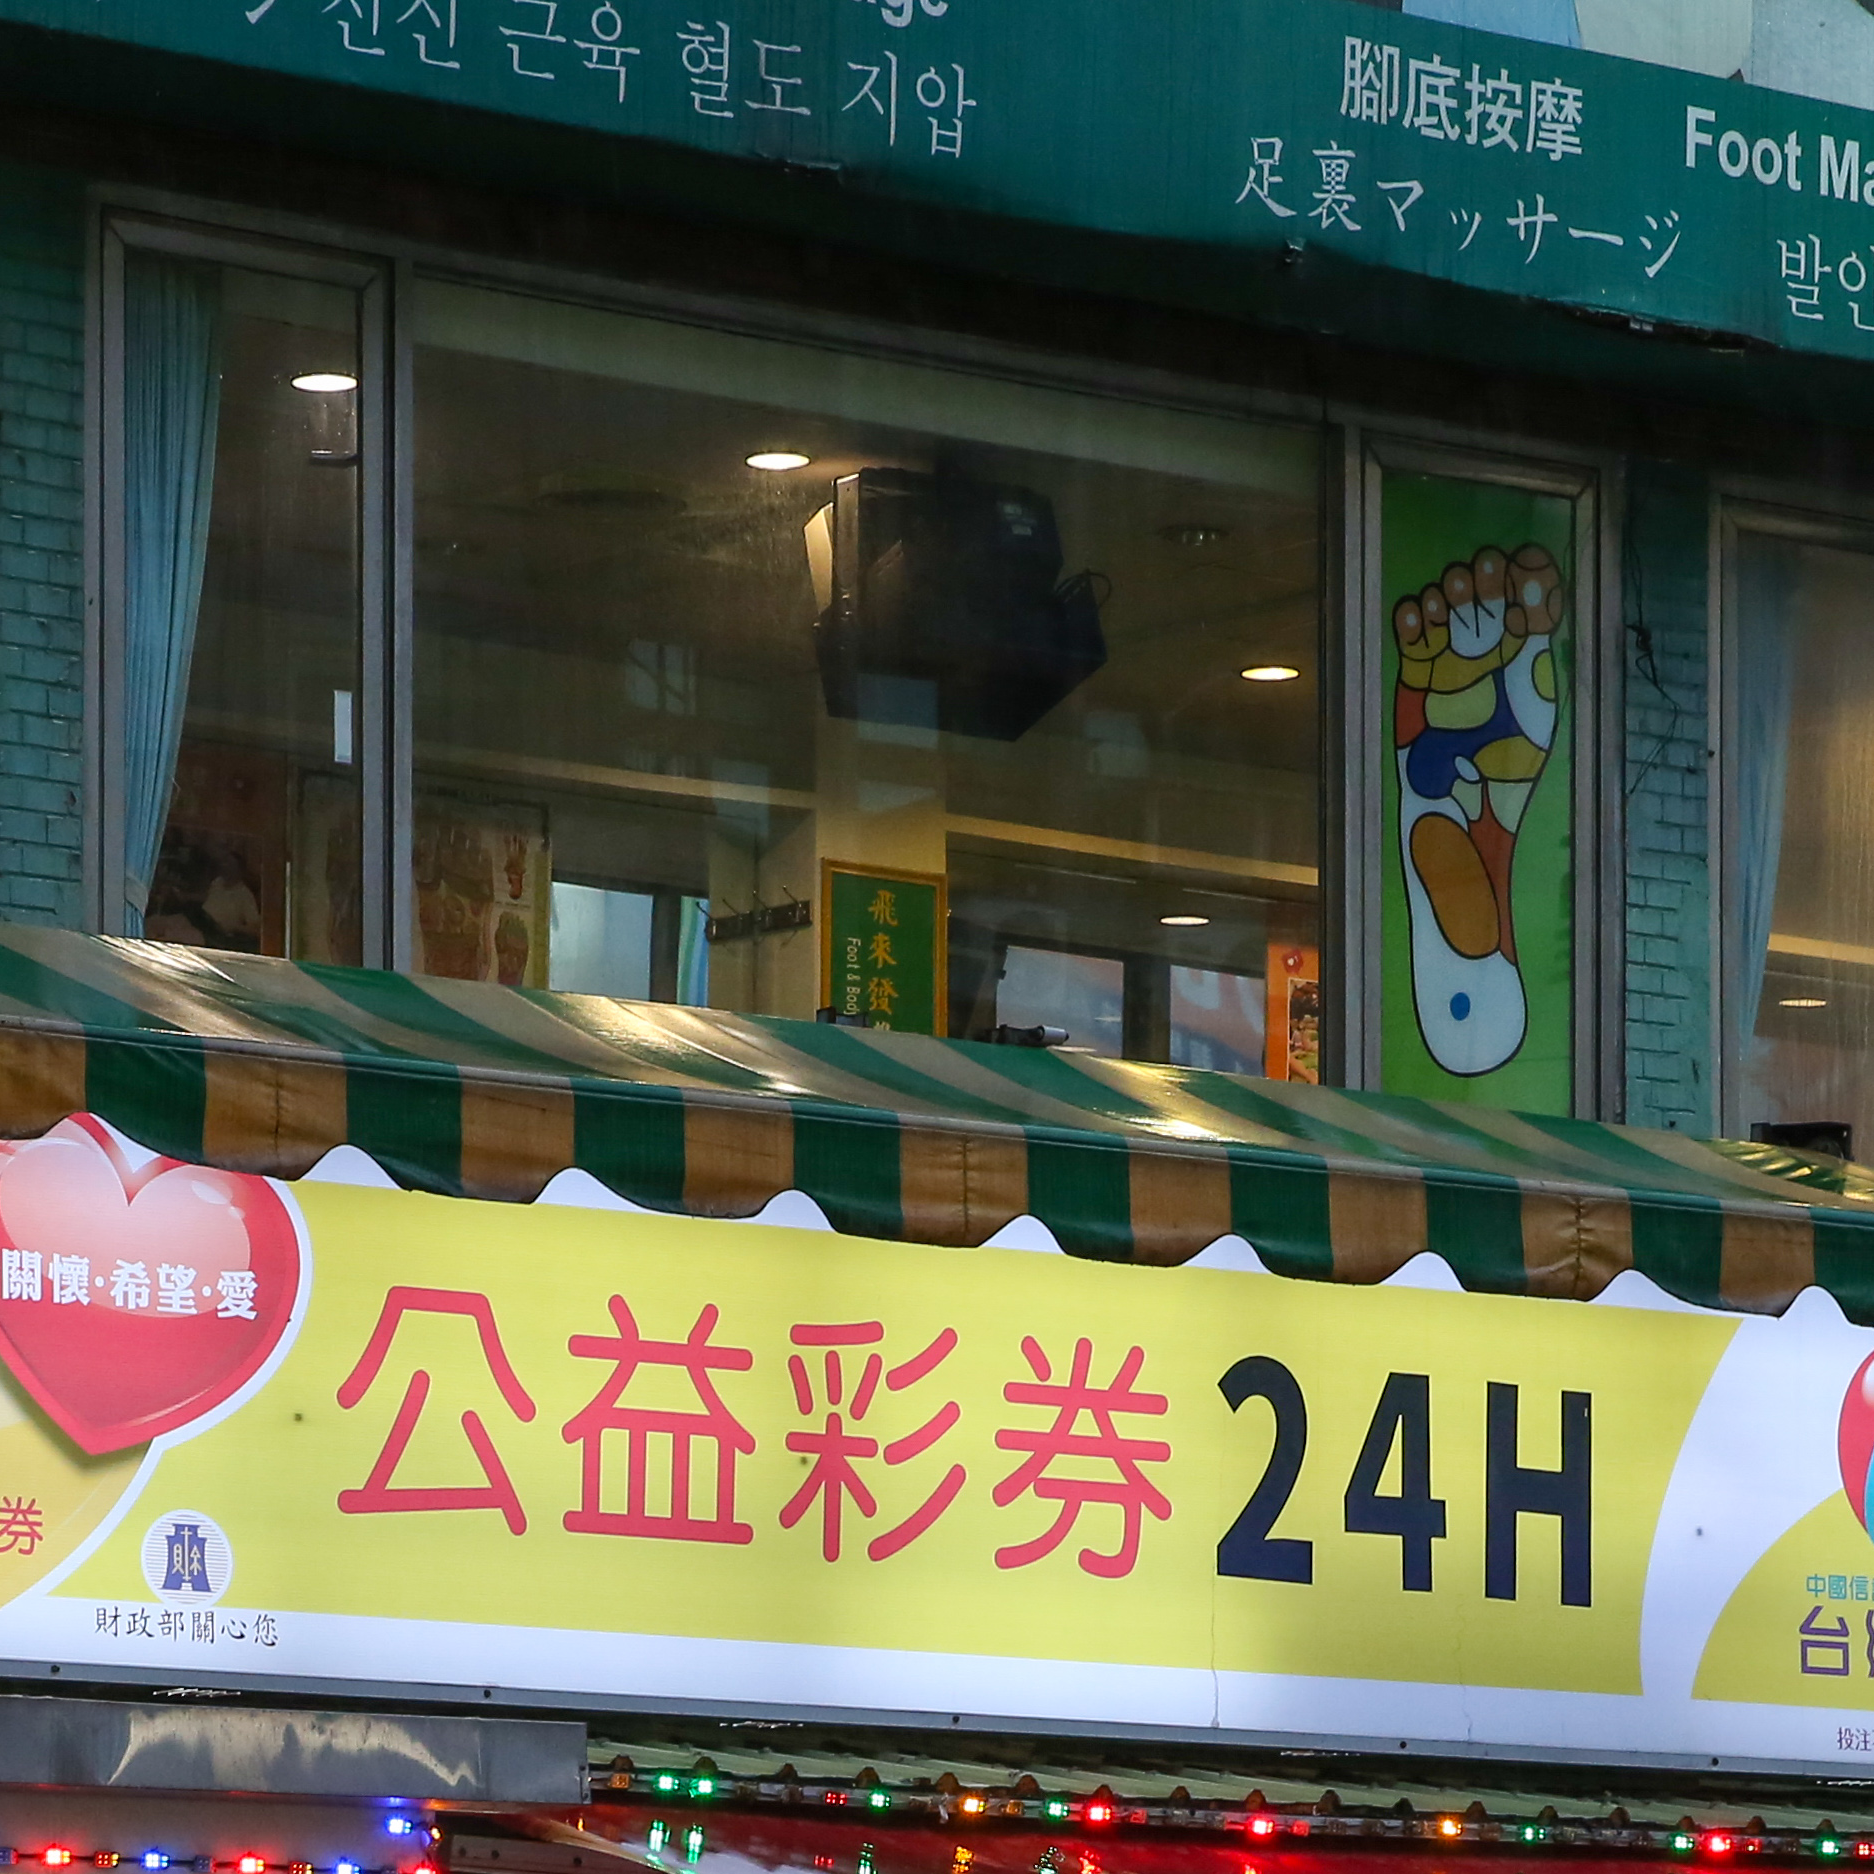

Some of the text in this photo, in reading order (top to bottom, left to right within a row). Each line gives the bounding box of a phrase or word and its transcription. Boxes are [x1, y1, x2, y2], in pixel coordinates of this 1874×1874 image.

[674, 17, 810, 120] 혈도
[841, 49, 977, 159] 지압
[1339, 35, 1585, 162] 腳底按摩
[1684, 105, 1803, 192] Foot
[1233, 135, 1682, 280] 足裏マッサージ
[868, 889, 899, 1031] 飛來發
[336, 1283, 1593, 1607] 公益彩券 24H
[95, 1606, 281, 1648] 財政部關心您
